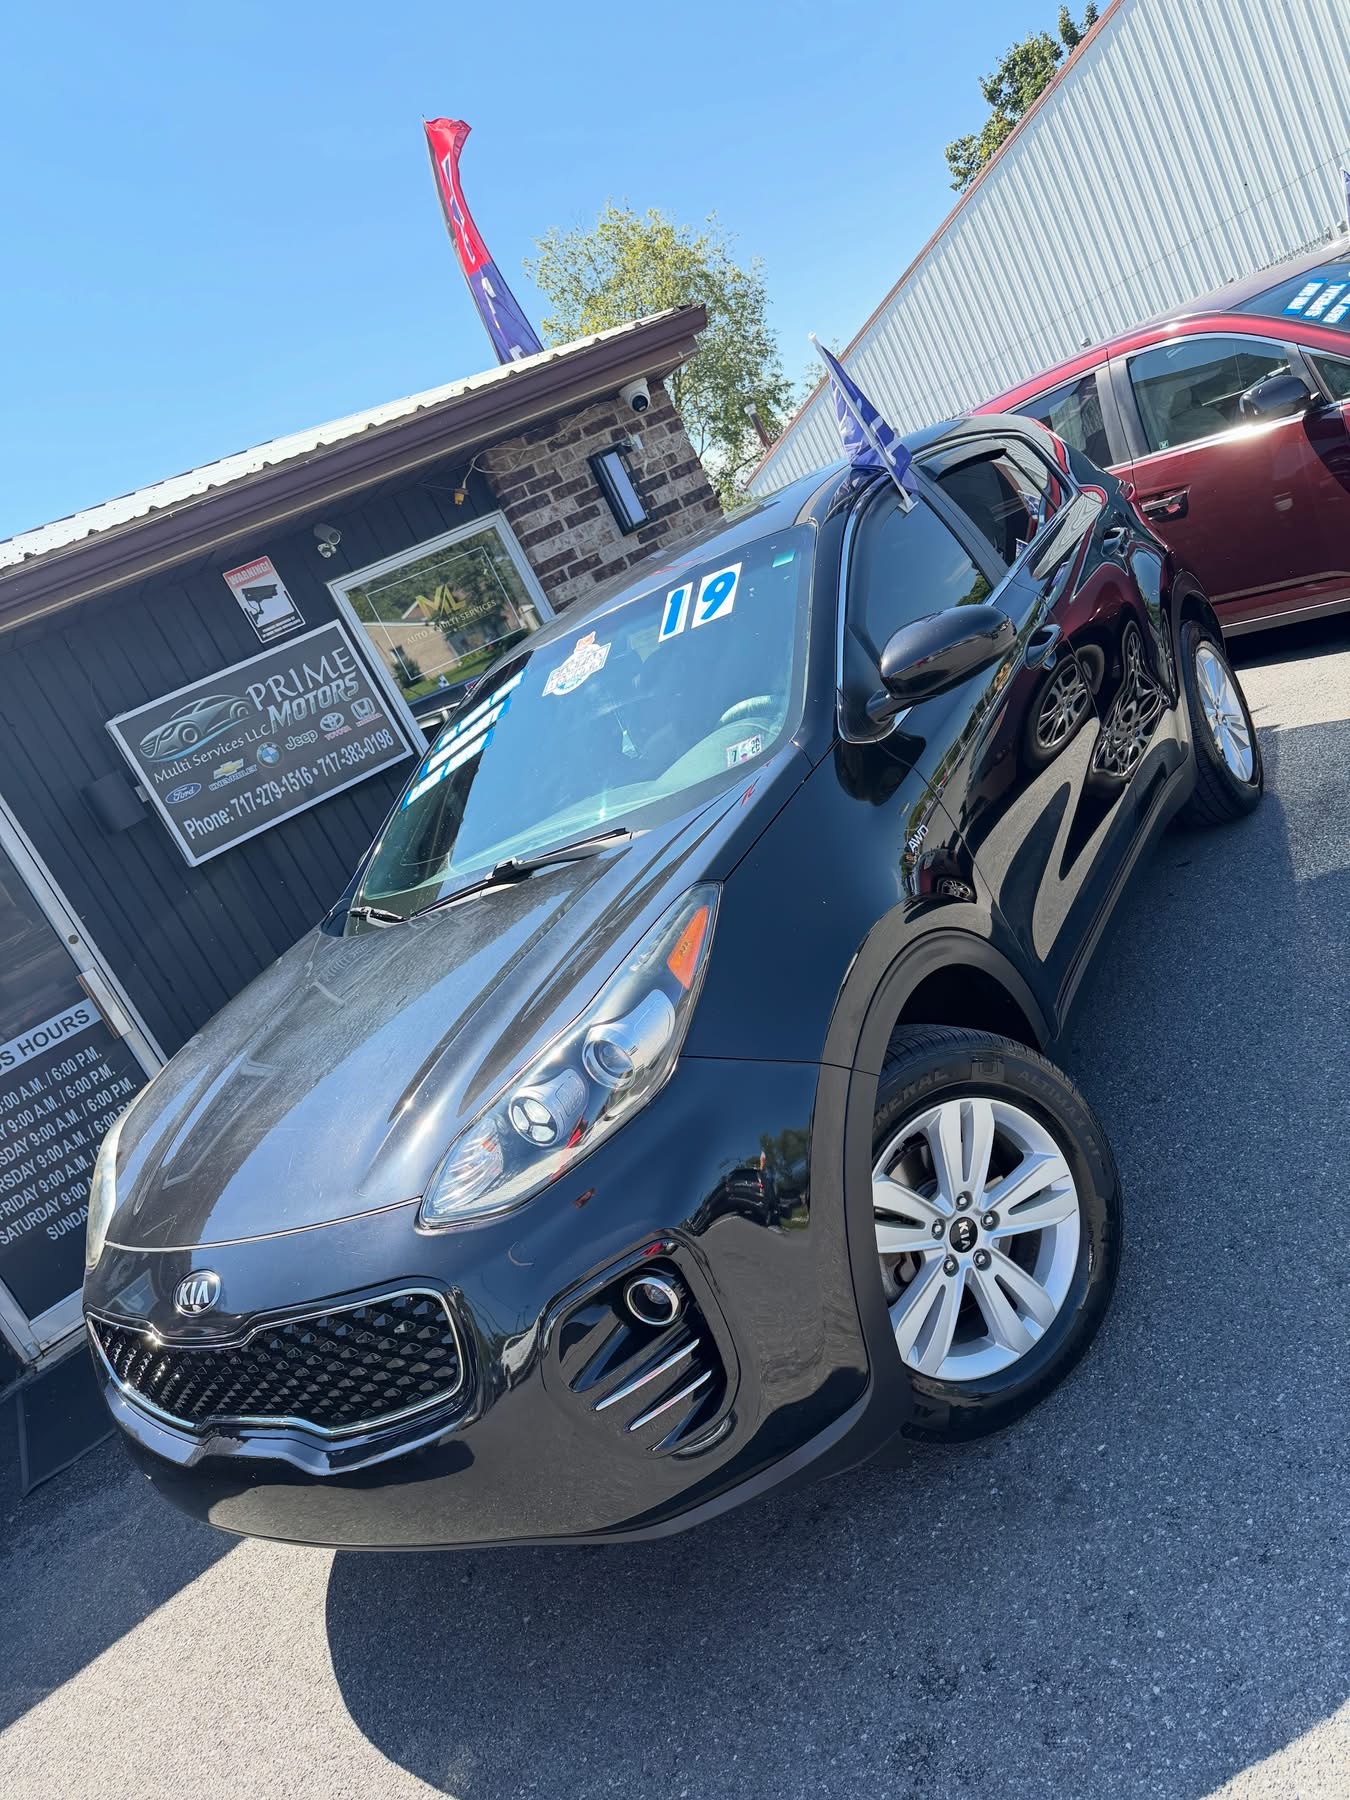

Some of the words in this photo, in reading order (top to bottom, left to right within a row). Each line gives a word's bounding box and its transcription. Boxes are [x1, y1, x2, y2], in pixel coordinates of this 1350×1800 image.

[407, 629, 429, 645] AUTO
[460, 599, 497, 621] SERVICES
[663, 571, 736, 636] 19
[245, 646, 357, 712] PRIME
[267, 672, 359, 734] MOTORS
[154, 759, 192, 783] Multi
[192, 737, 245, 767] Services
[245, 724, 271, 743] LLC
[285, 729, 319, 751] Jeep
[183, 807, 235, 840] Phone:
[230, 766, 314, 817] 717-279-1516
[317, 728, 394, 777] 717-383-0198
[908, 824, 929, 853] AWD
[0, 1050, 16, 1071] S
[17, 1009, 90, 1057] HOURS
[7, 1109, 34, 1132] 9:00
[34, 1095, 61, 1119] A.M.
[65, 1076, 91, 1098] 6:00
[89, 1063, 116, 1085] P.M.
[19, 1077, 47, 1101] A.M.
[51, 1058, 78, 1081] 6:00
[75, 1046, 102, 1067] P.M.
[873, 1066, 949, 1129] NERAL
[0, 1137, 29, 1167] SDAY
[29, 1122, 56, 1146] 9:00
[56, 1109, 83, 1132] A.M.
[86, 1090, 113, 1112] 6:00
[110, 1077, 136, 1098] P.M.
[36, 1144, 63, 1169] 9:00
[63, 1130, 90, 1154] A.M.
[38, 1169, 65, 1193] 9:00
[65, 1155, 92, 1178] A.M.
[0, 1196, 62, 1245] SATURDAY
[60, 1182, 87, 1205] 9:00
[46, 1205, 89, 1240] SUNDA
[958, 1221, 971, 1250] KIA
[179, 1280, 210, 1306] KIA
